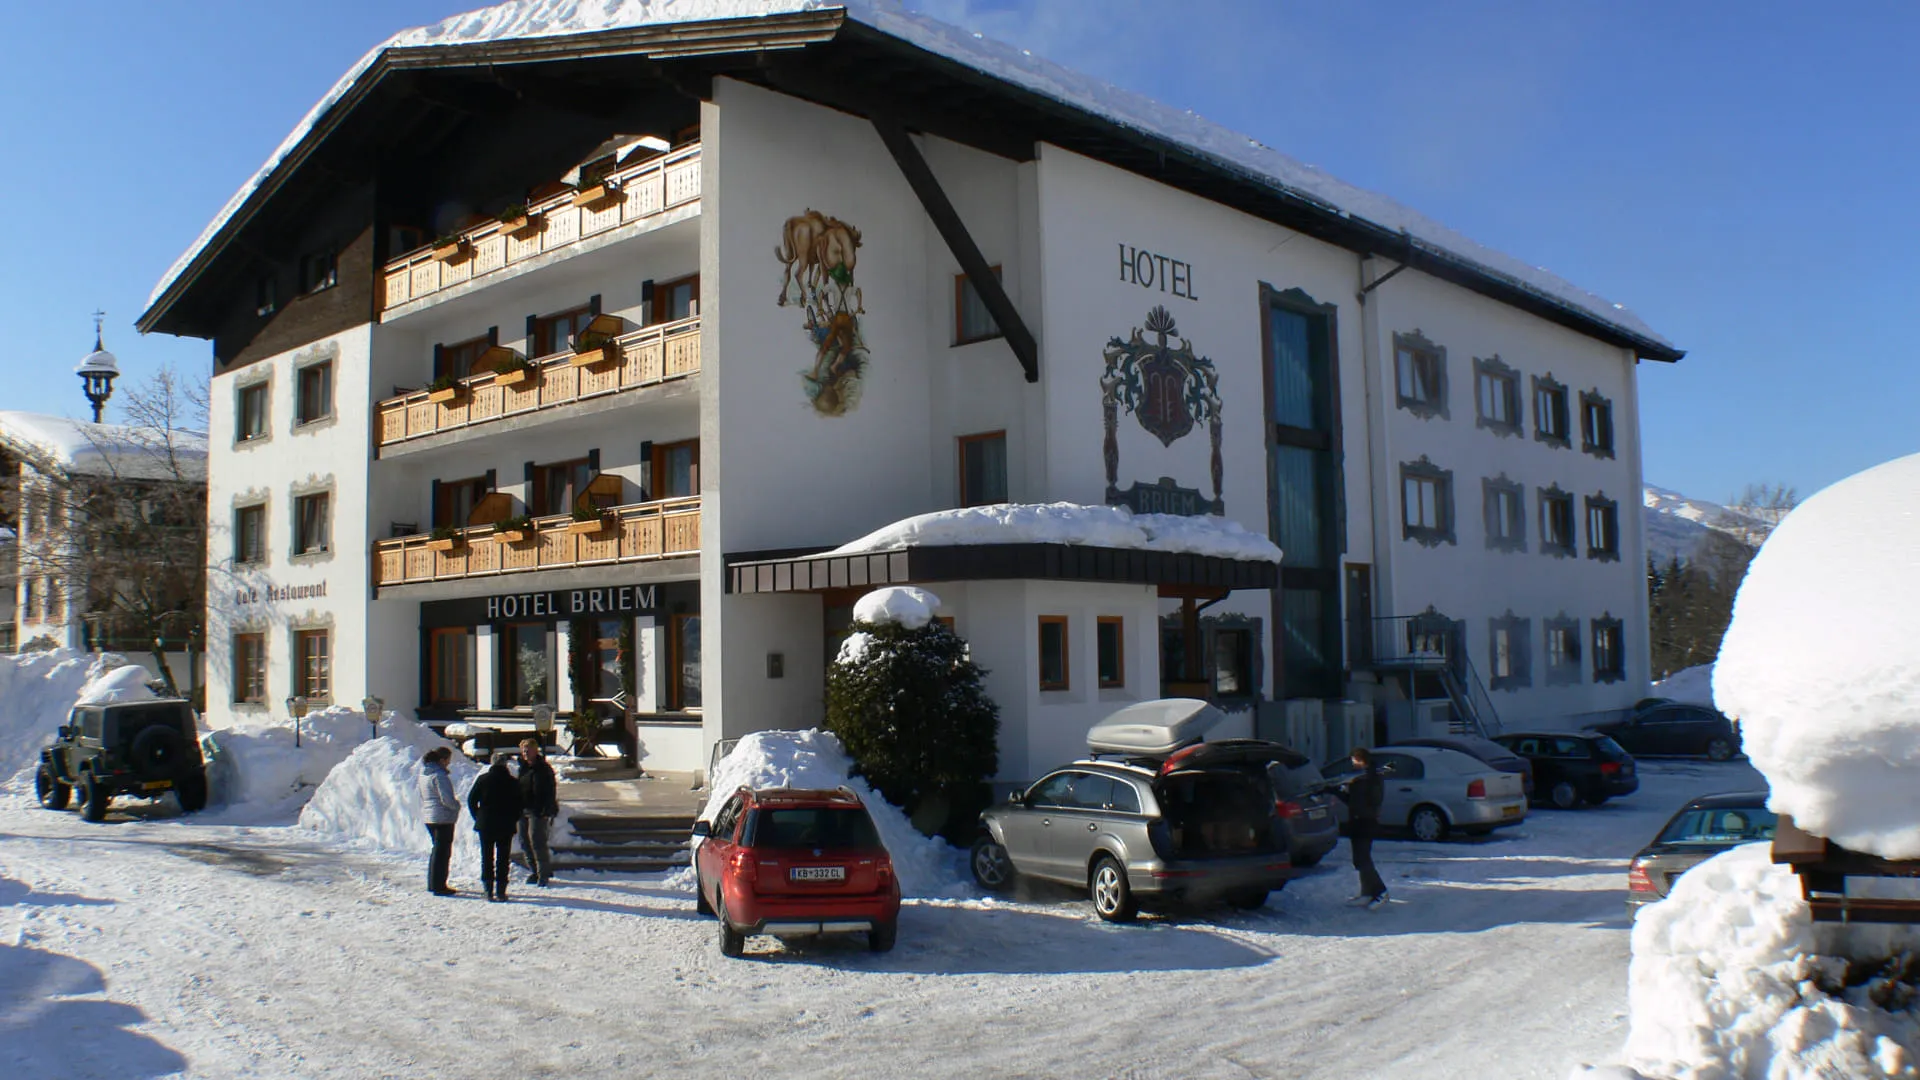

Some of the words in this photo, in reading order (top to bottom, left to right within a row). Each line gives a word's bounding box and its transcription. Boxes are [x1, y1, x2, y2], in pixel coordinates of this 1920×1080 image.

[1118, 242, 1198, 301] HOTEL
[1139, 489, 1196, 515] BRIEM
[267, 578, 327, 602] Restaurant
[487, 593, 559, 619] HOTEL
[571, 585, 656, 613] BRIEM
